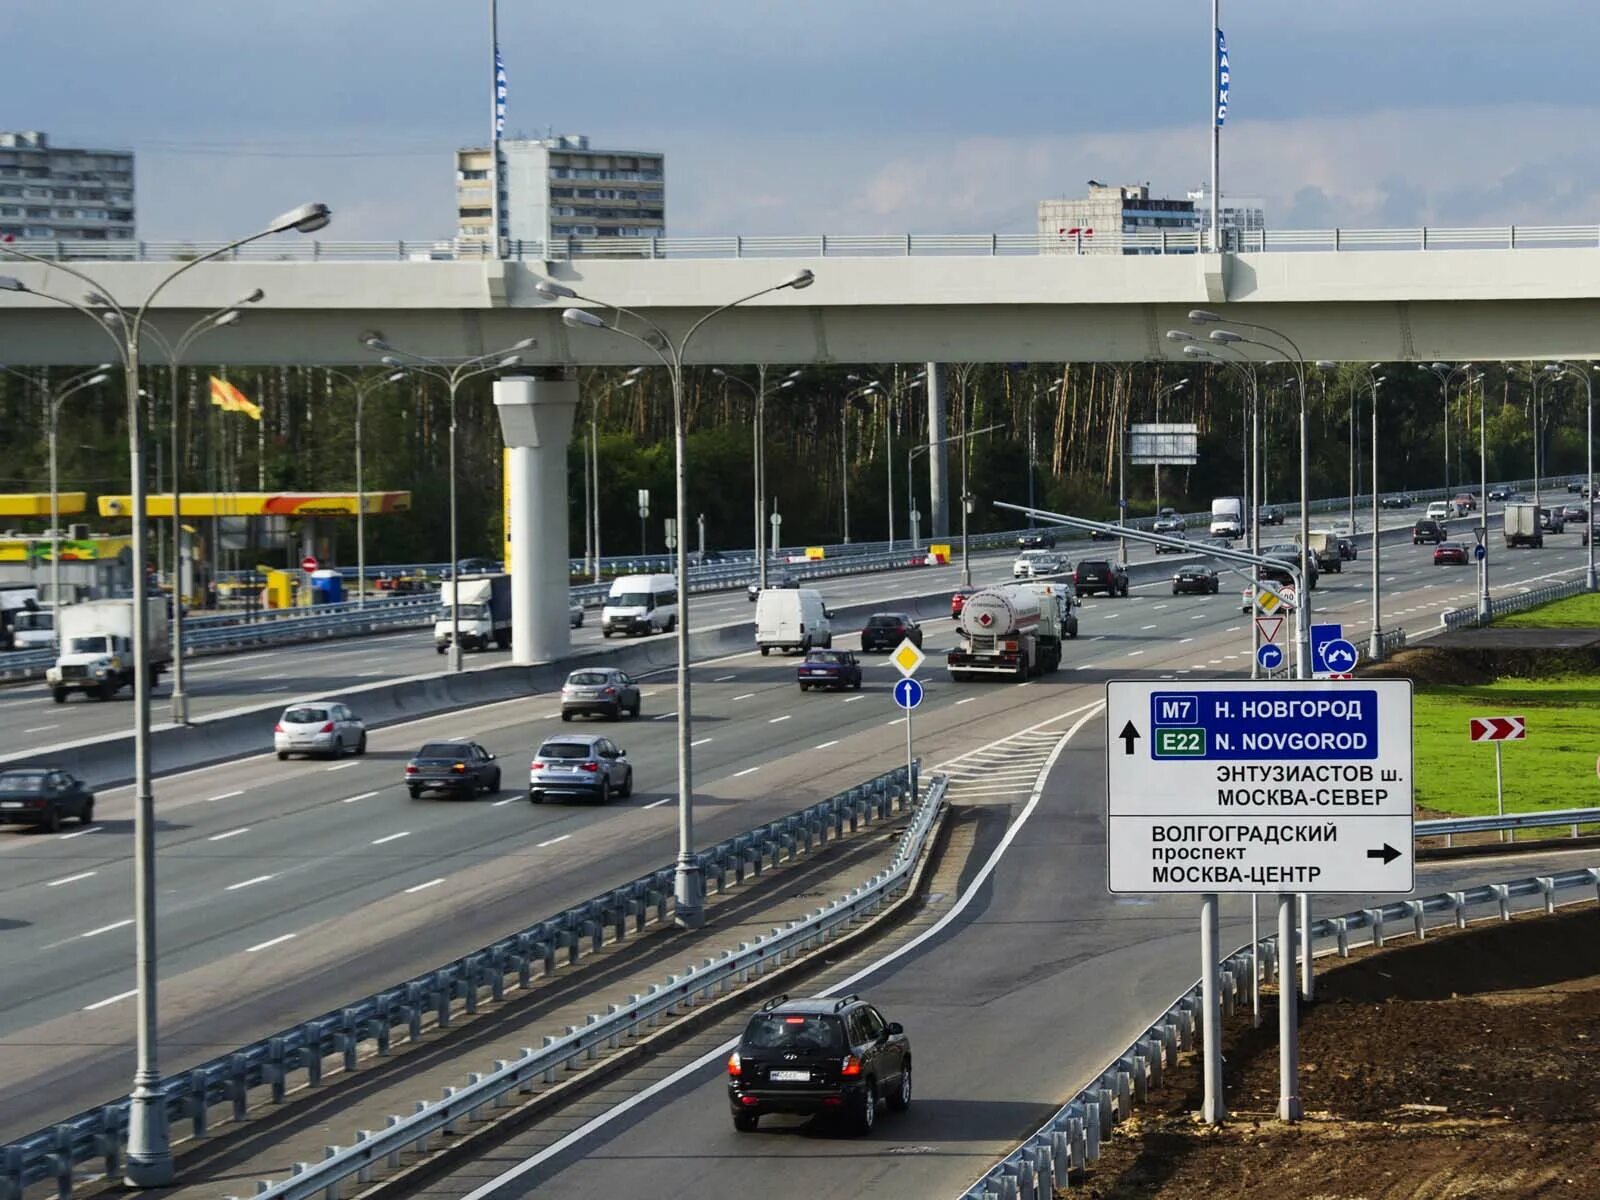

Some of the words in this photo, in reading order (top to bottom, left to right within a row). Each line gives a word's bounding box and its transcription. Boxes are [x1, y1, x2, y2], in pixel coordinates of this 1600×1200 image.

[1163, 702, 1190, 718] М7
[1216, 702, 1234, 717] Н.
[1243, 701, 1361, 720] НОВГОРОД
[1164, 734, 1199, 750] E22
[1216, 734, 1235, 749] N.
[1243, 733, 1366, 749] NOVGOROD
[1217, 766, 1373, 782] ЭНТУЗИАСТОВ
[1381, 770, 1402, 781] ш.
[1218, 789, 1387, 805] МОСКВА-СЕВЕР
[1153, 823, 1336, 845] ВОЛГОГРАДСКИЙ
[1153, 848, 1246, 860] проспект
[1153, 866, 1320, 885] МОСКВА-ЦЕНТР
